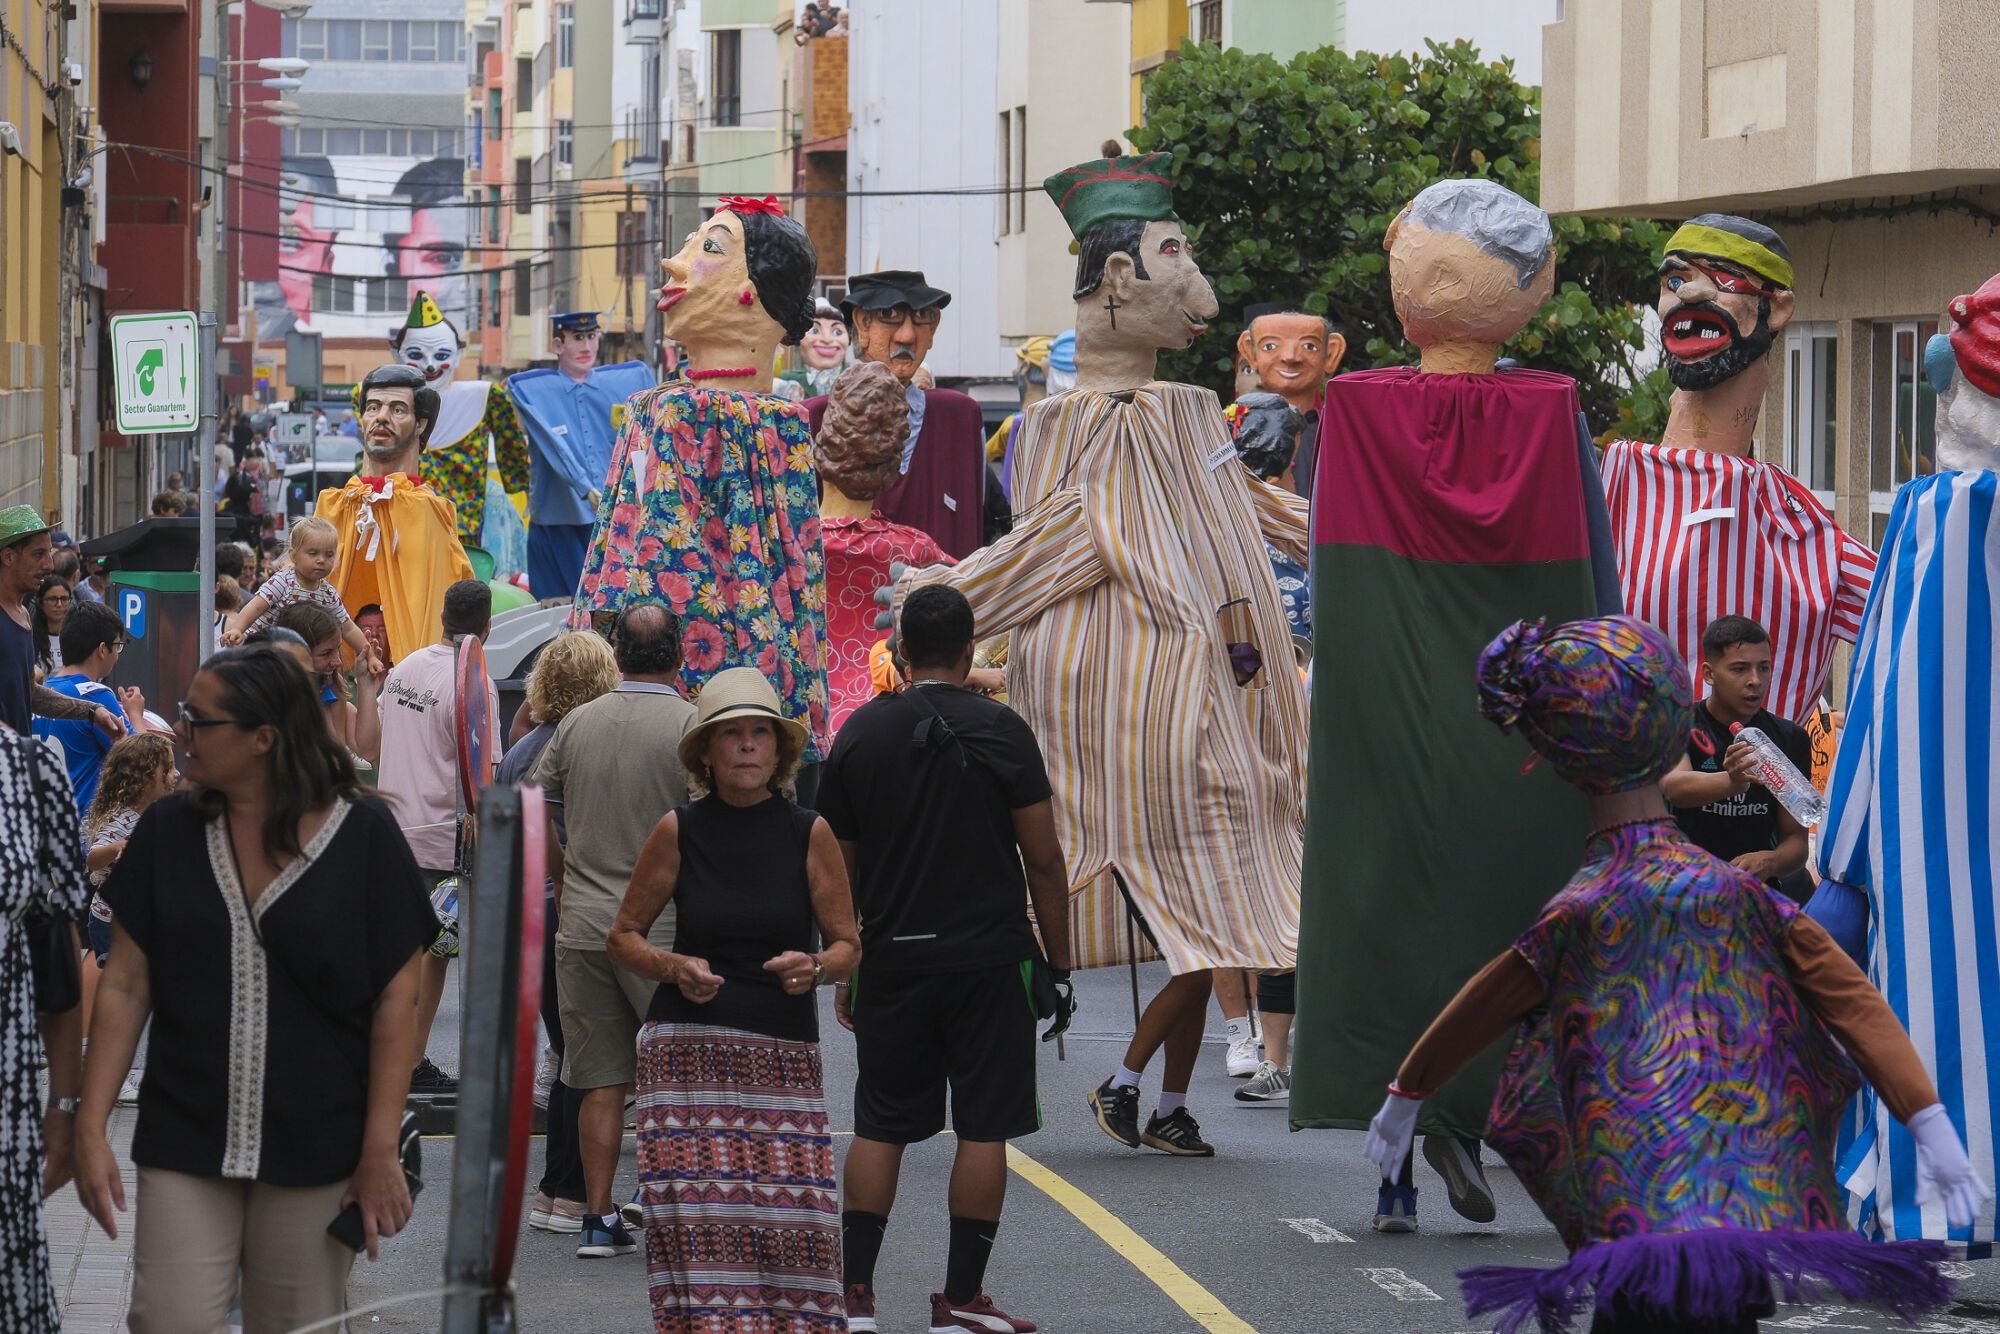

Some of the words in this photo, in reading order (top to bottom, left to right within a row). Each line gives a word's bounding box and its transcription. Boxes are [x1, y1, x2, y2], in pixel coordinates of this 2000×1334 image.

[124, 404, 147, 414] Sector
[147, 402, 187, 413] Guanarteme
[126, 593, 142, 629] P
[1760, 763, 1785, 788] FIRGAS
